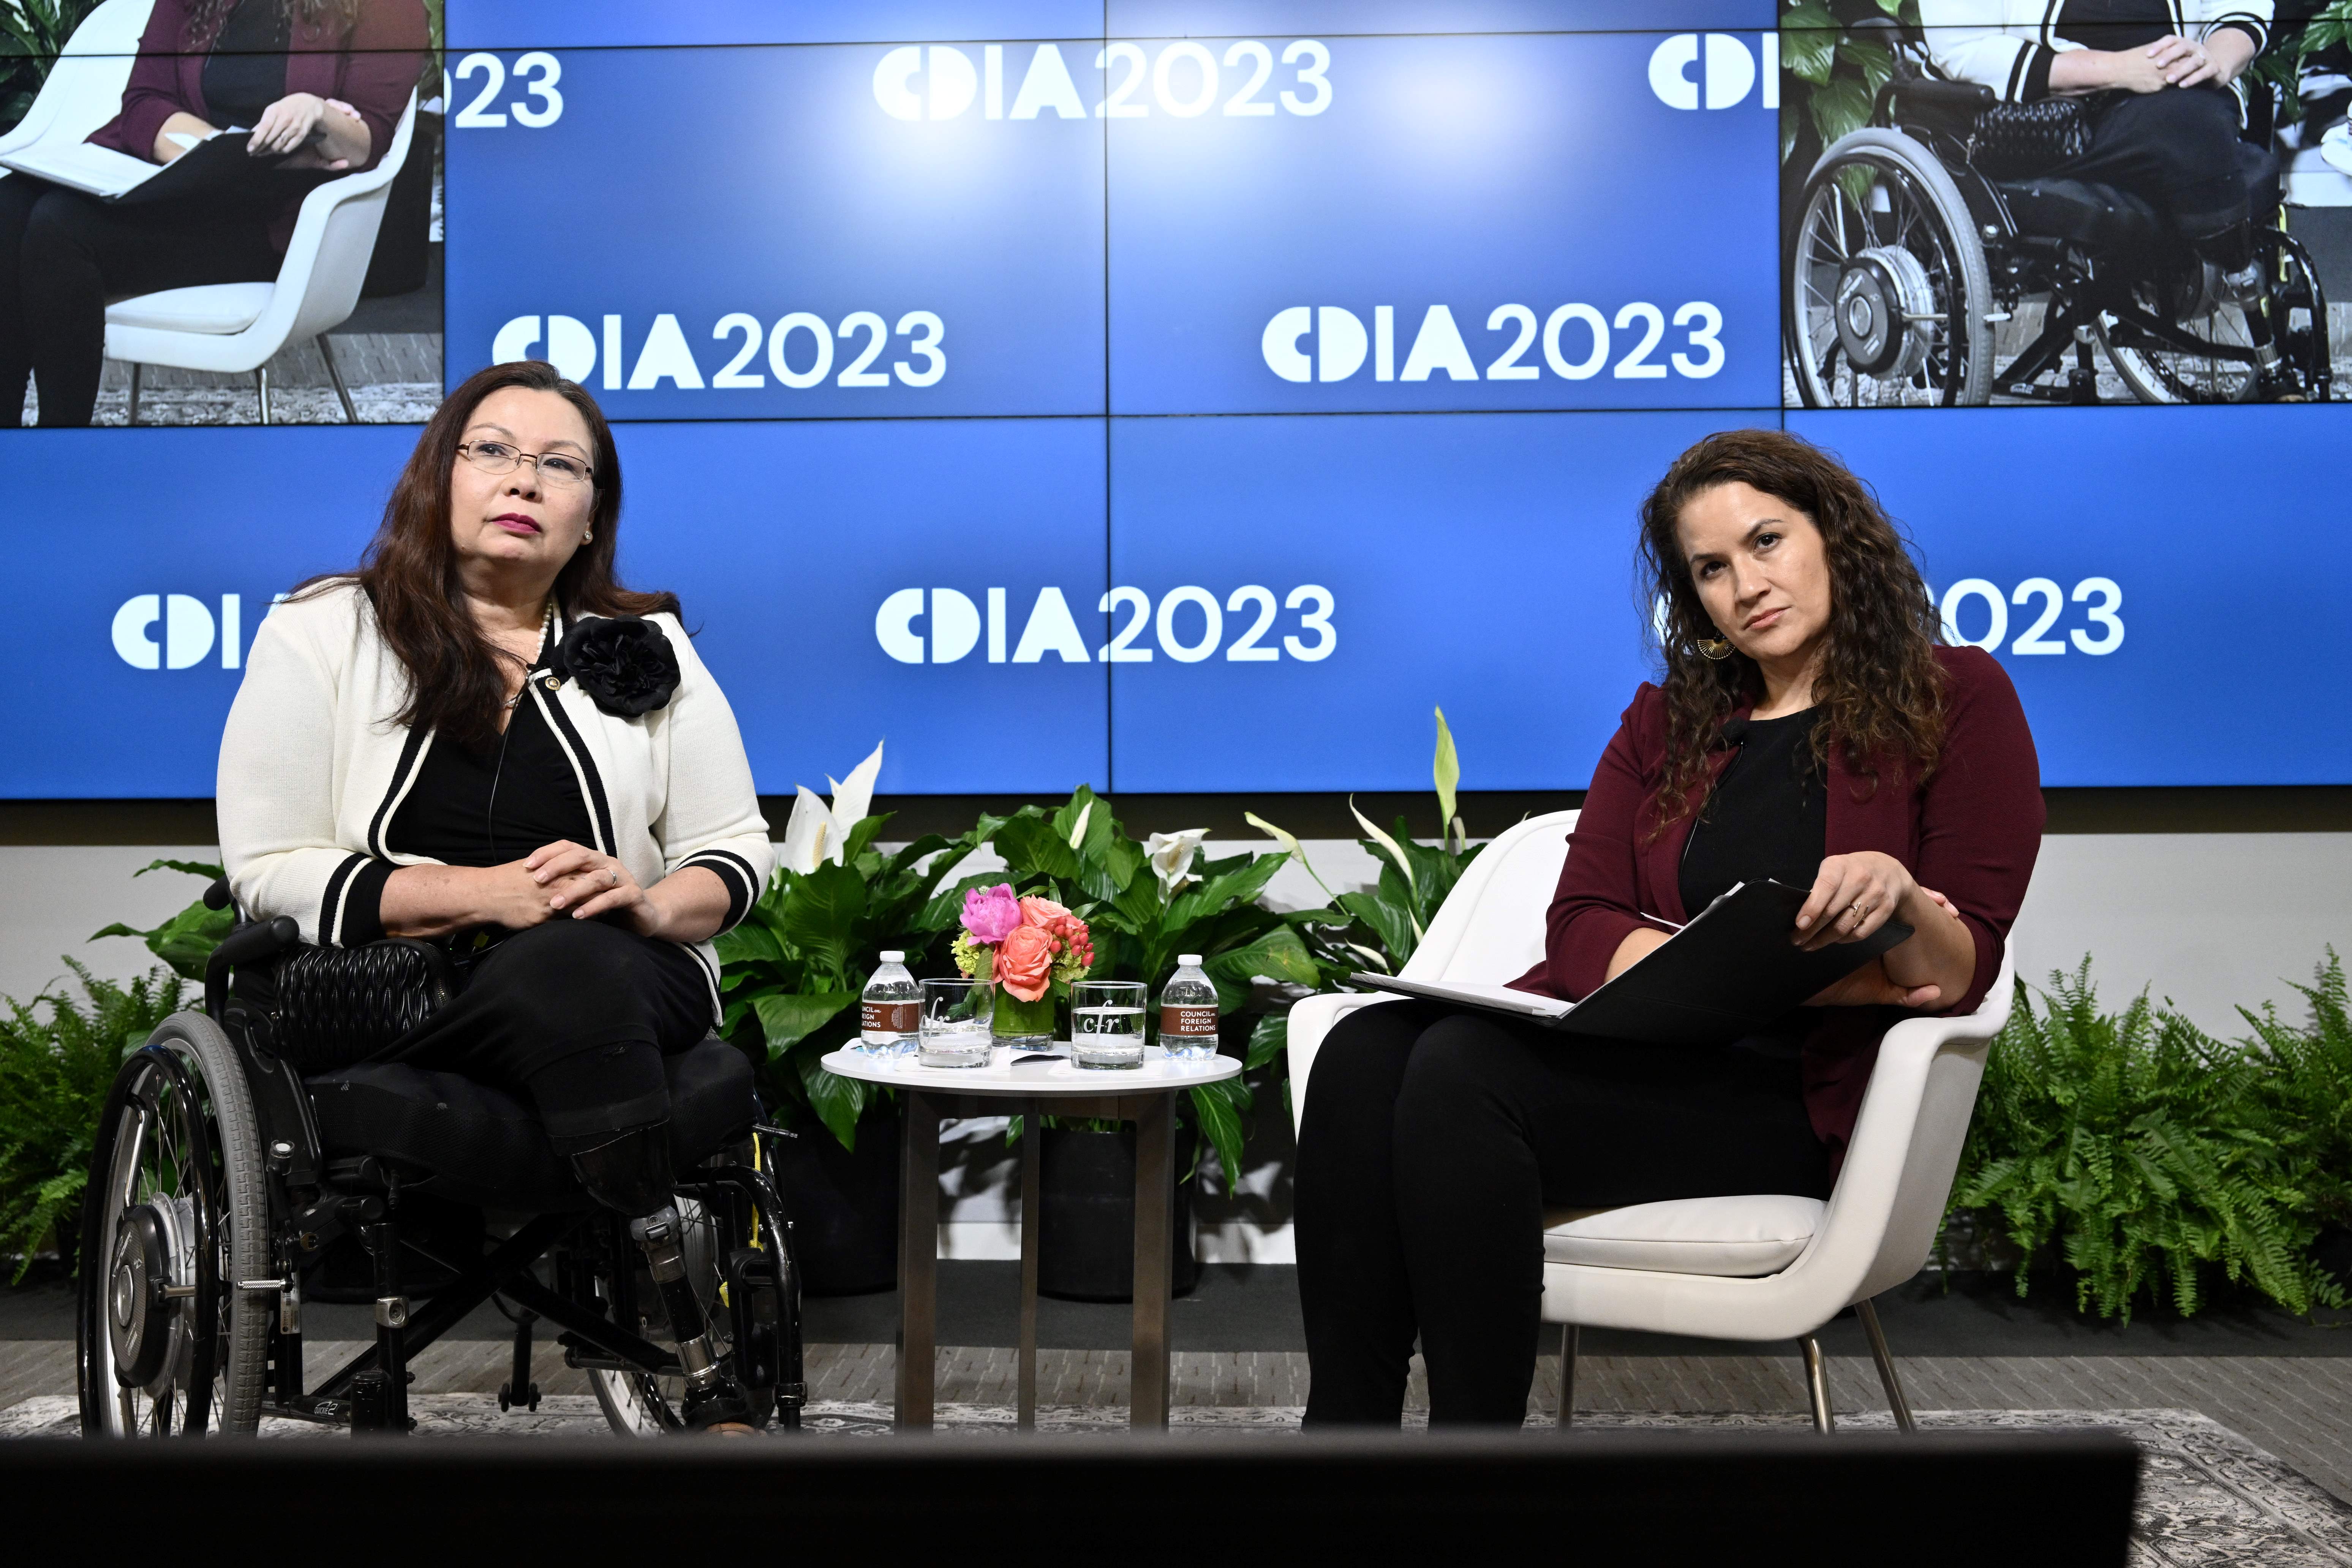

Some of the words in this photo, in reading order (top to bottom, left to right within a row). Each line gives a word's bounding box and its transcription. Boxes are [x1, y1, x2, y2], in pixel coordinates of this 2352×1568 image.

[445, 52, 563, 128] 23
[112, 594, 289, 669] CDI
[1924, 577, 2124, 655] 023
[1083, 999, 1119, 1043] cfr
